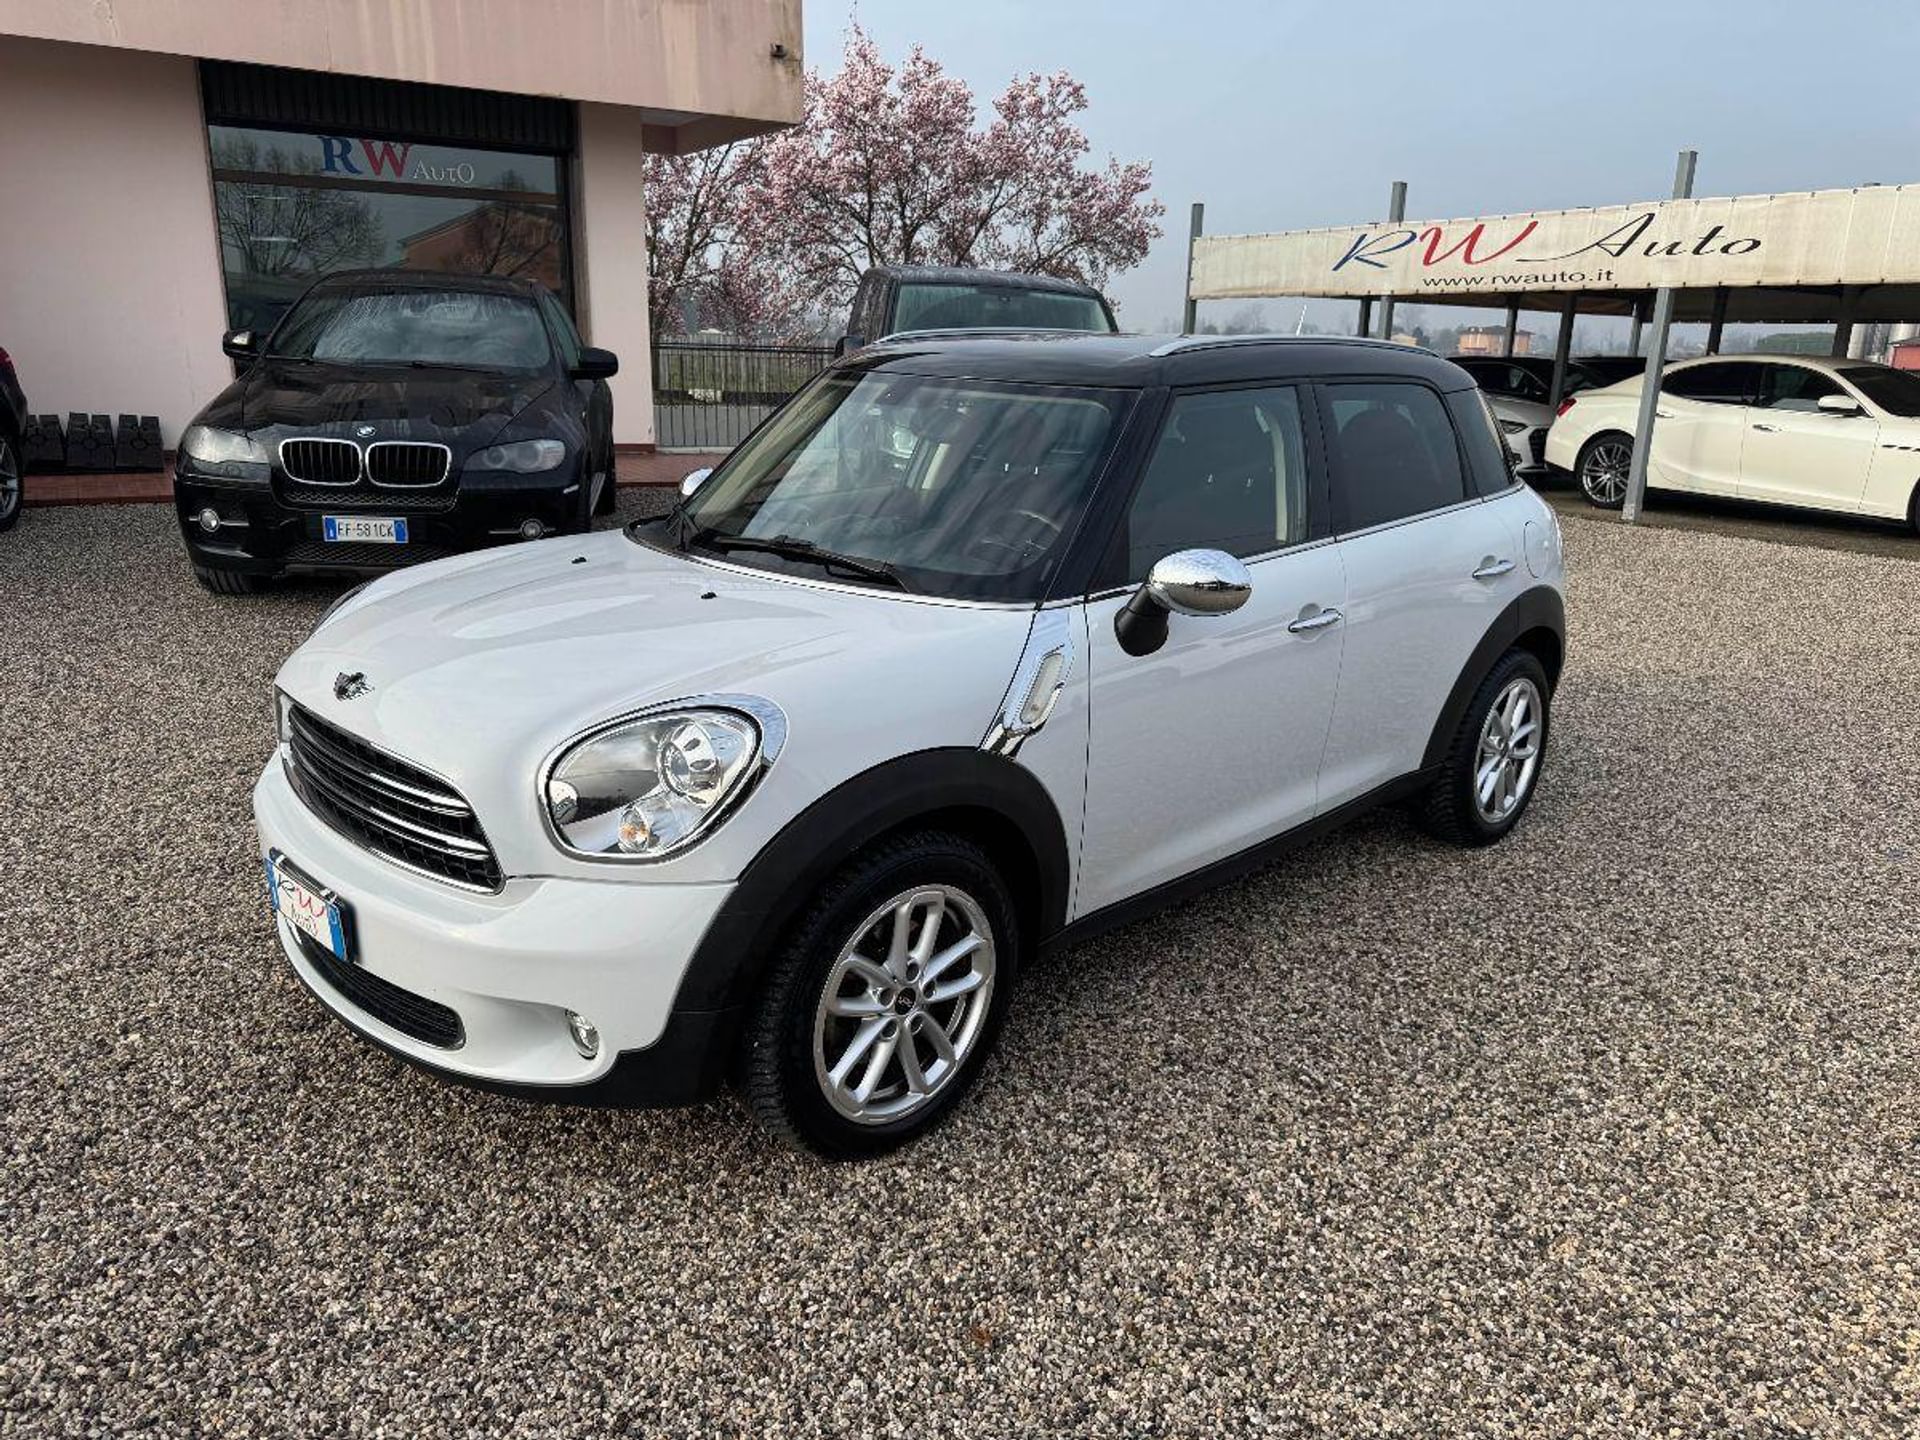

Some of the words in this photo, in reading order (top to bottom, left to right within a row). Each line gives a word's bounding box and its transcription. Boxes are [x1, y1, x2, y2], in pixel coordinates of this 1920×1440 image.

[319, 136, 412, 178] RW
[1331, 220, 1538, 272] RW
[1516, 212, 1762, 263] Auto
[1423, 269, 1614, 287] www.rwauto.it
